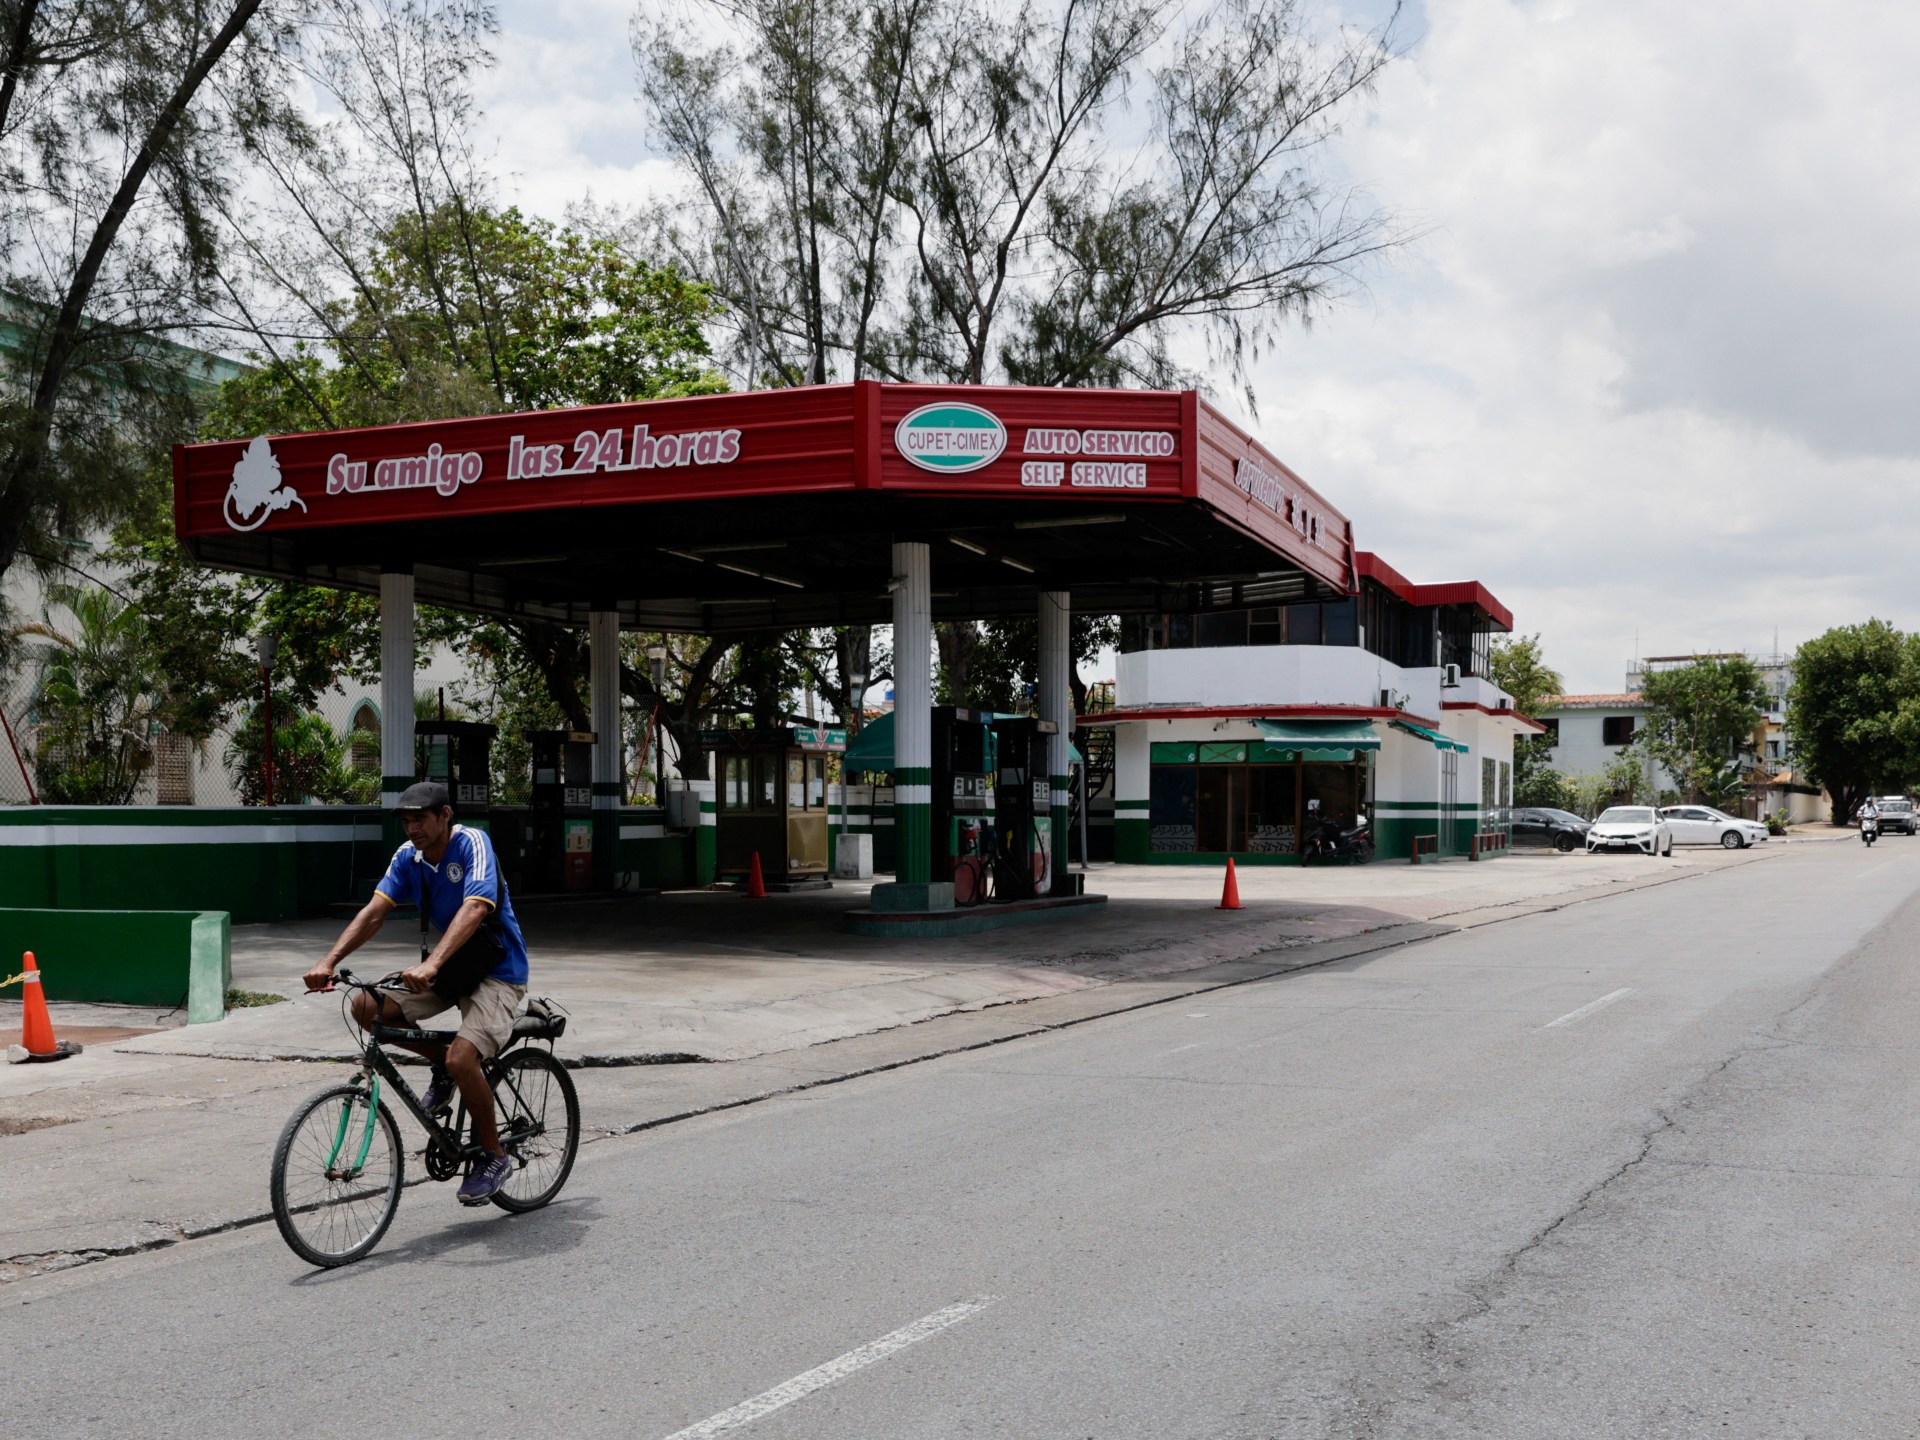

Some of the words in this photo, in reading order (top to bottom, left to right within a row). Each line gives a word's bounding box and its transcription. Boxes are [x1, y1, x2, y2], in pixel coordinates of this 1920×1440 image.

[907, 431, 998, 450] CUPET-CIMEX
[1024, 429, 1081, 453] AUTO
[1082, 431, 1173, 455] SERVICIO
[326, 453, 367, 494] Su
[375, 443, 482, 496] amigo
[508, 435, 563, 479] las
[573, 430, 622, 473] 24
[630, 424, 741, 469] horas
[1021, 462, 1064, 486] SELF
[1071, 462, 1147, 488] SERVICE
